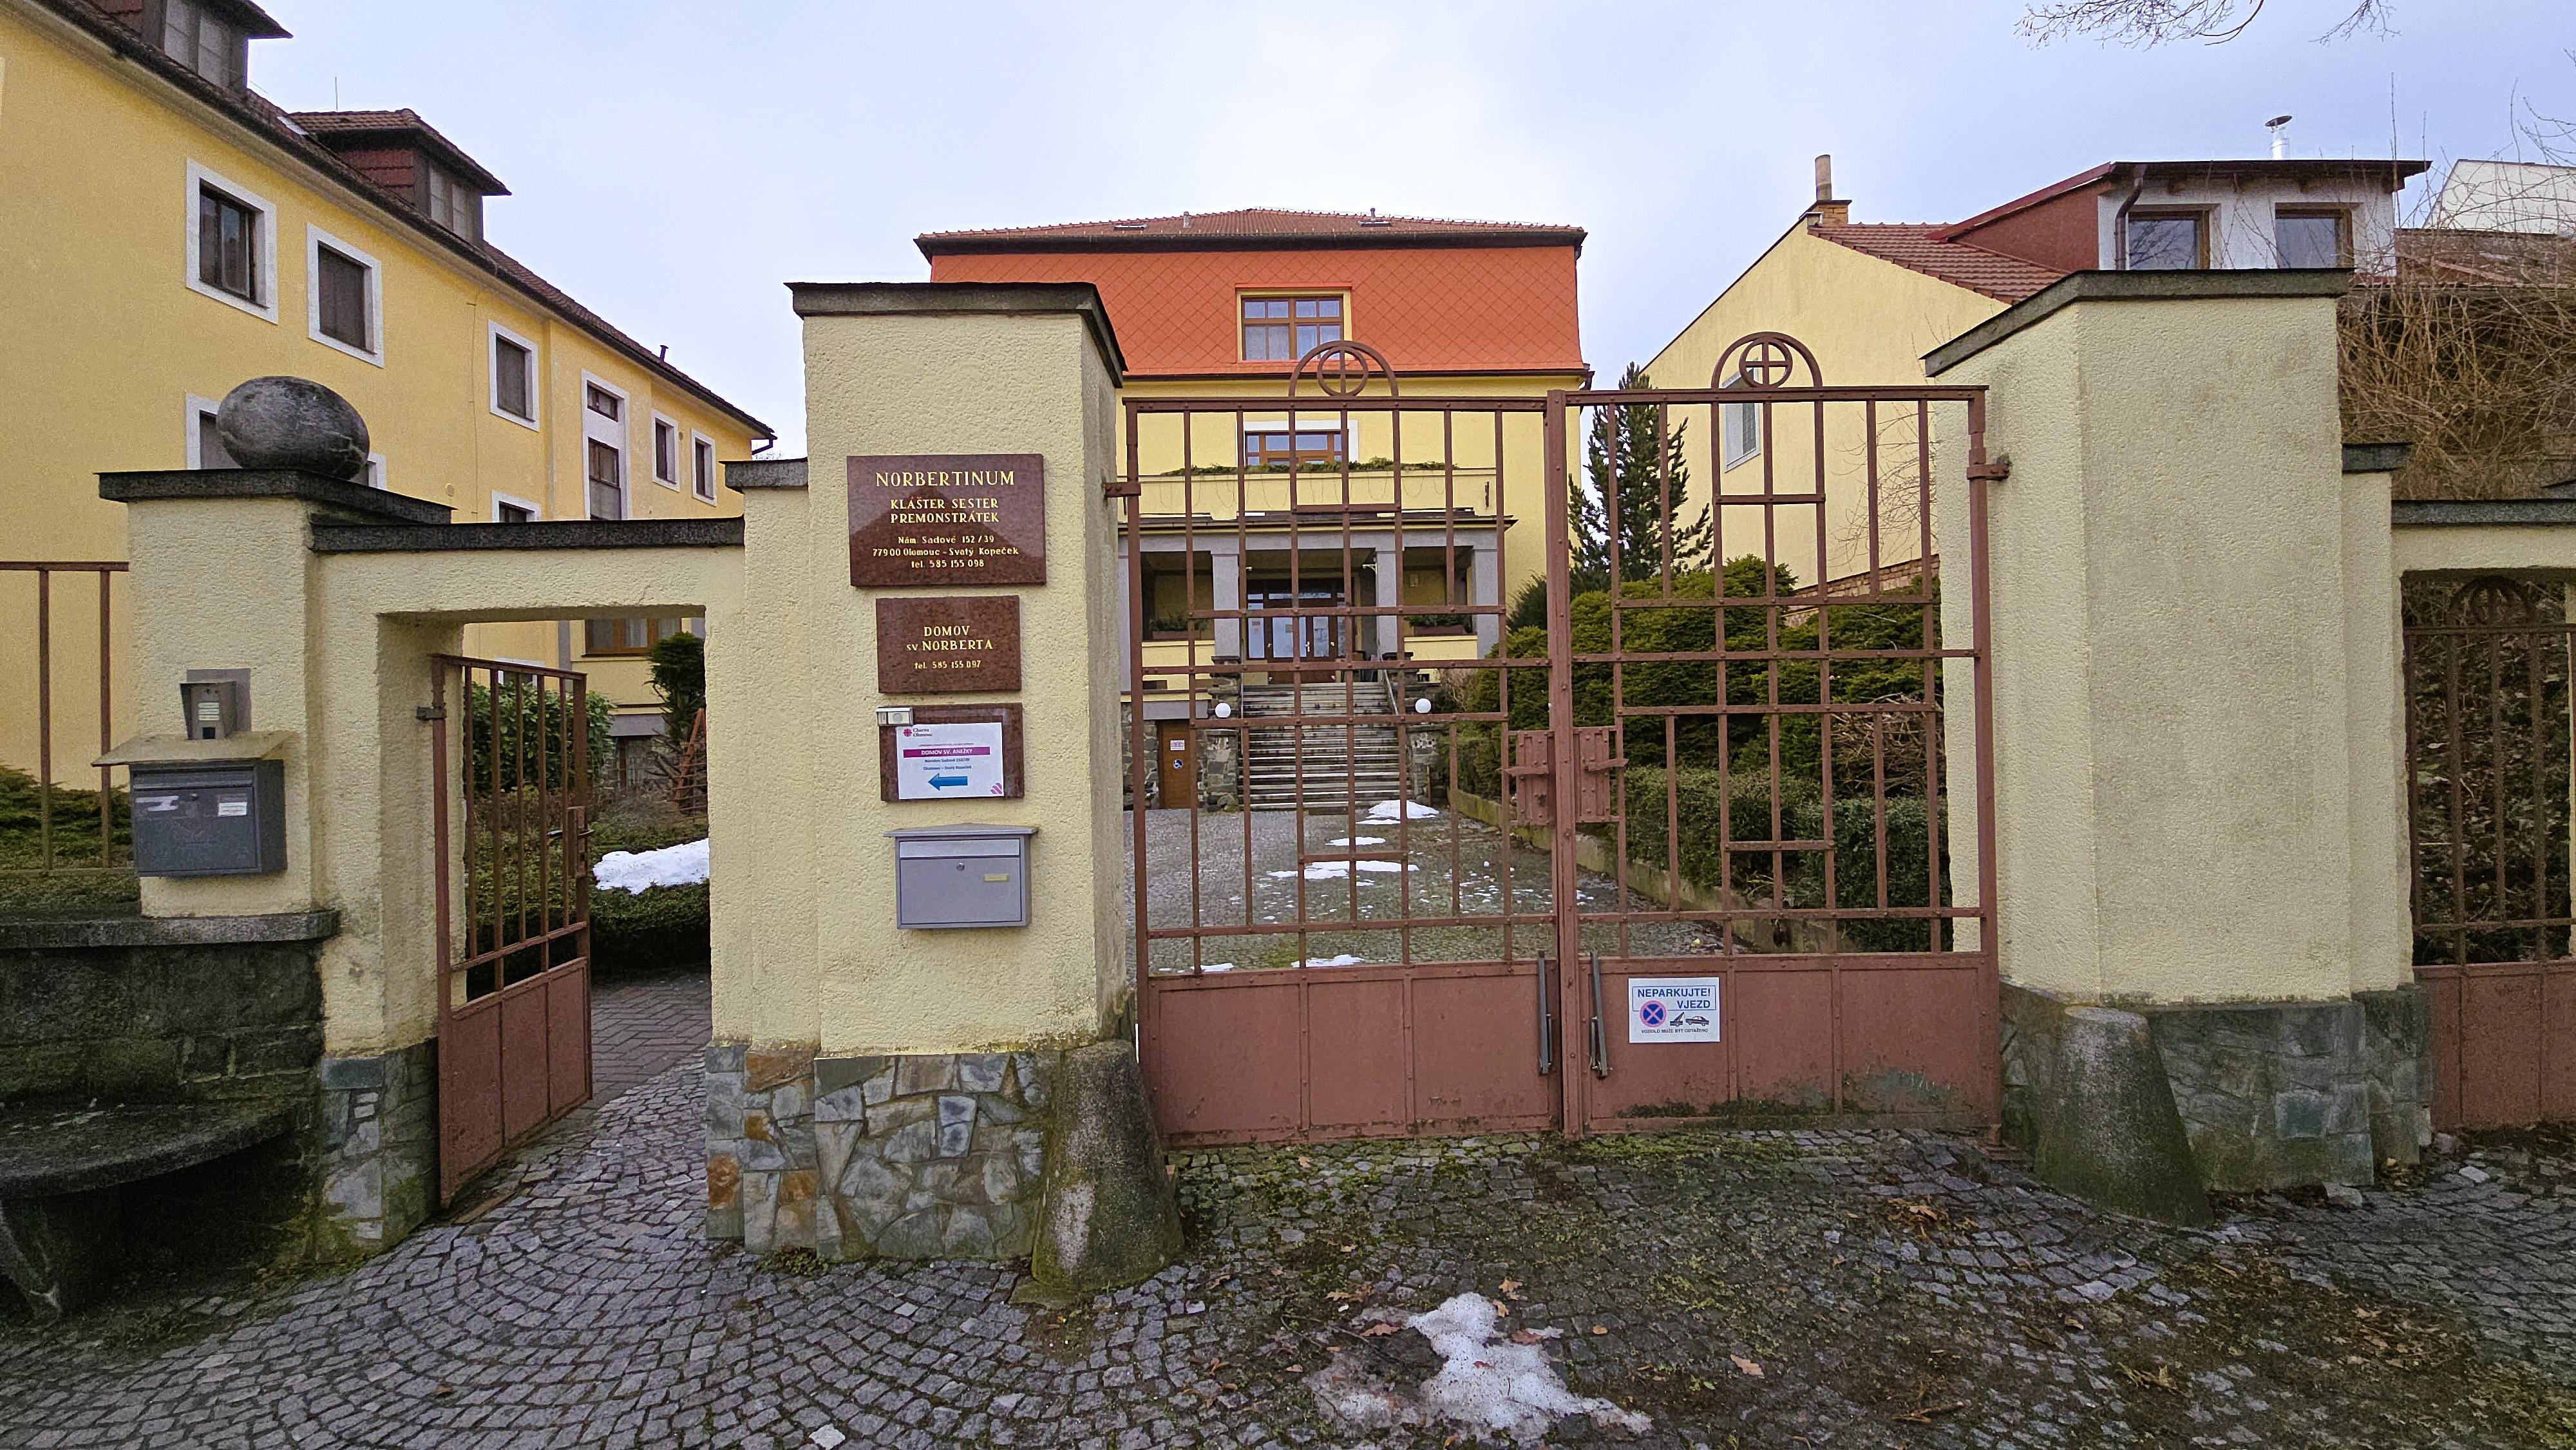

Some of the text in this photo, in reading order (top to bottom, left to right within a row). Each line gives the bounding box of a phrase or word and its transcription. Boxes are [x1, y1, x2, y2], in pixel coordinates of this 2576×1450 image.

[876, 471, 1014, 487] NORBERTINUM
[890, 496, 999, 509] KLÁŠTER SESTER
[890, 511, 999, 523] PREMONSTRÁTEK
[922, 535, 956, 544] Sadové
[903, 548, 940, 556] Olomouc
[949, 547, 974, 557] Svatý
[979, 547, 1019, 556] Kopeček
[929, 560, 947, 568] 585
[951, 560, 965, 568] 155
[967, 559, 985, 567] 098
[923, 625, 971, 637] DOMOV
[922, 639, 993, 651] NORBERTA
[932, 661, 947, 669] 585
[966, 660, 981, 668] 097
[1638, 988, 1710, 998] NEPARKUJTE!
[1677, 1000, 1710, 1009] VJEZD
